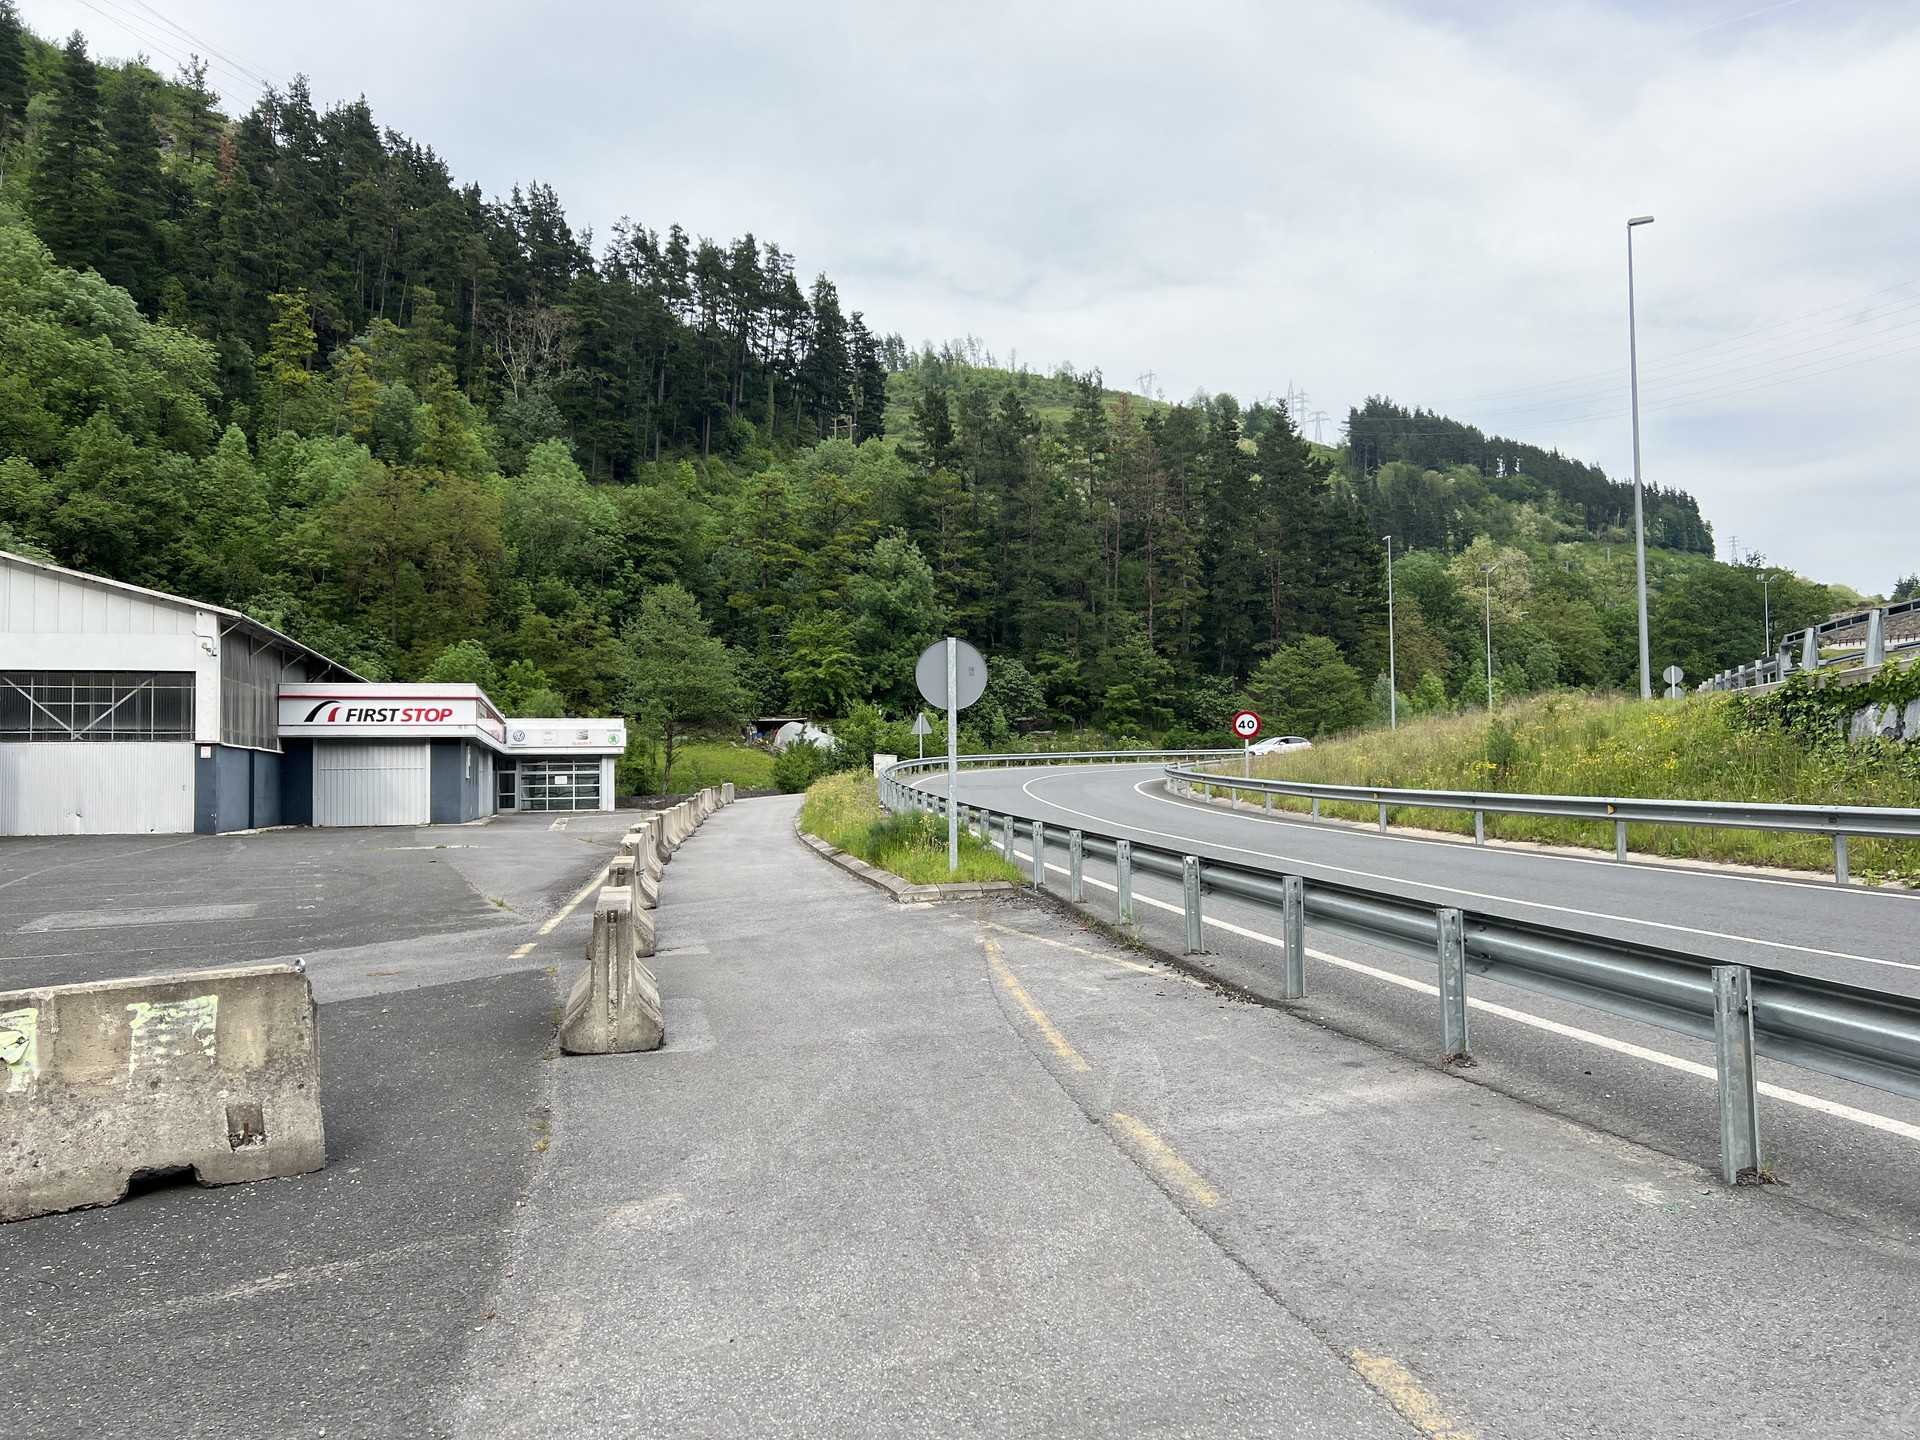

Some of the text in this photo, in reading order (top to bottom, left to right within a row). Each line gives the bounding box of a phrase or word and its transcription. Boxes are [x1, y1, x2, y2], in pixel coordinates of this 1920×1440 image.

[345, 708, 453, 722] FIRST STOP
[1238, 720, 1255, 729] 40
